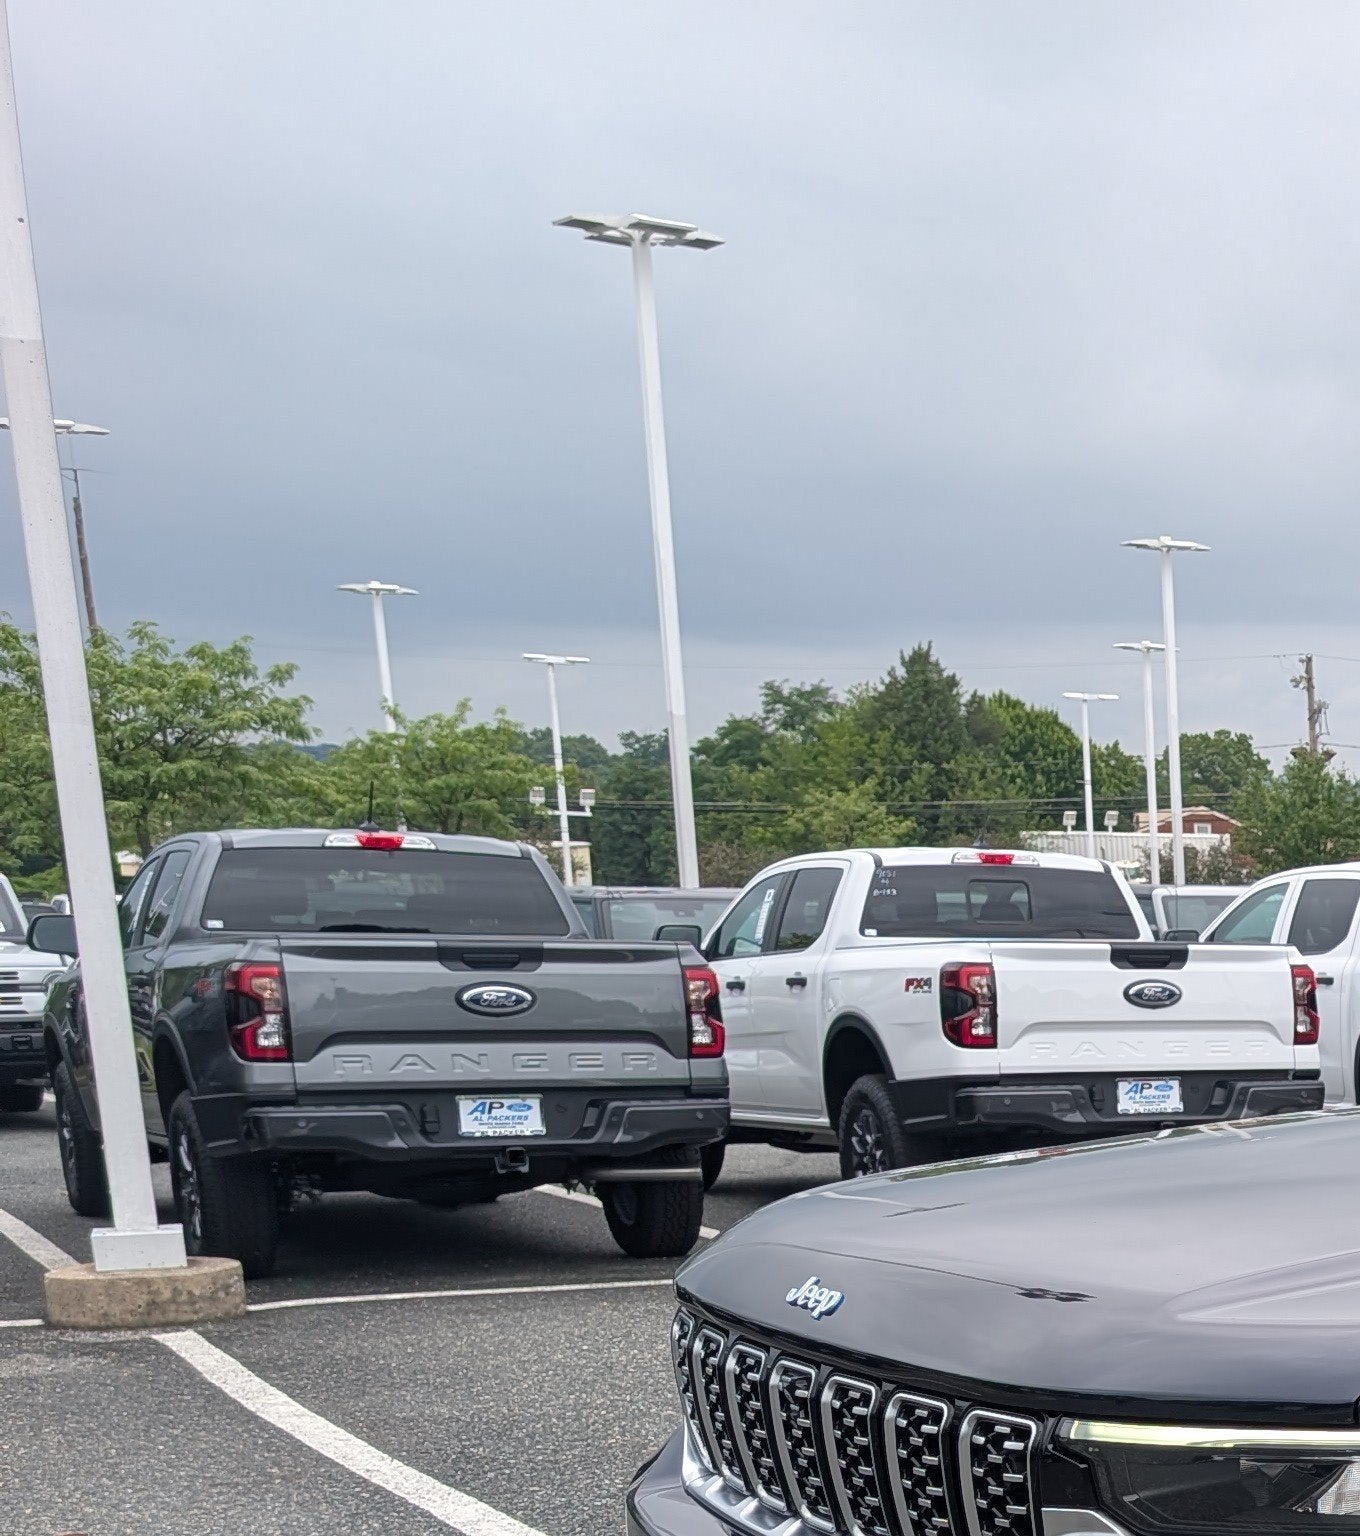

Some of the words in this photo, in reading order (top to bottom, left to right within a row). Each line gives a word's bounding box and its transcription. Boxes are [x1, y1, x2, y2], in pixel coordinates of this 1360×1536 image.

[904, 977, 932, 992] FX4
[1029, 1040, 1271, 1059] RANGER
[332, 1052, 658, 1075] RANGER
[1124, 1083, 1152, 1095] AP
[467, 1101, 505, 1115] AP
[487, 1114, 529, 1122] PACKERS
[785, 1276, 844, 1320] Jeep
